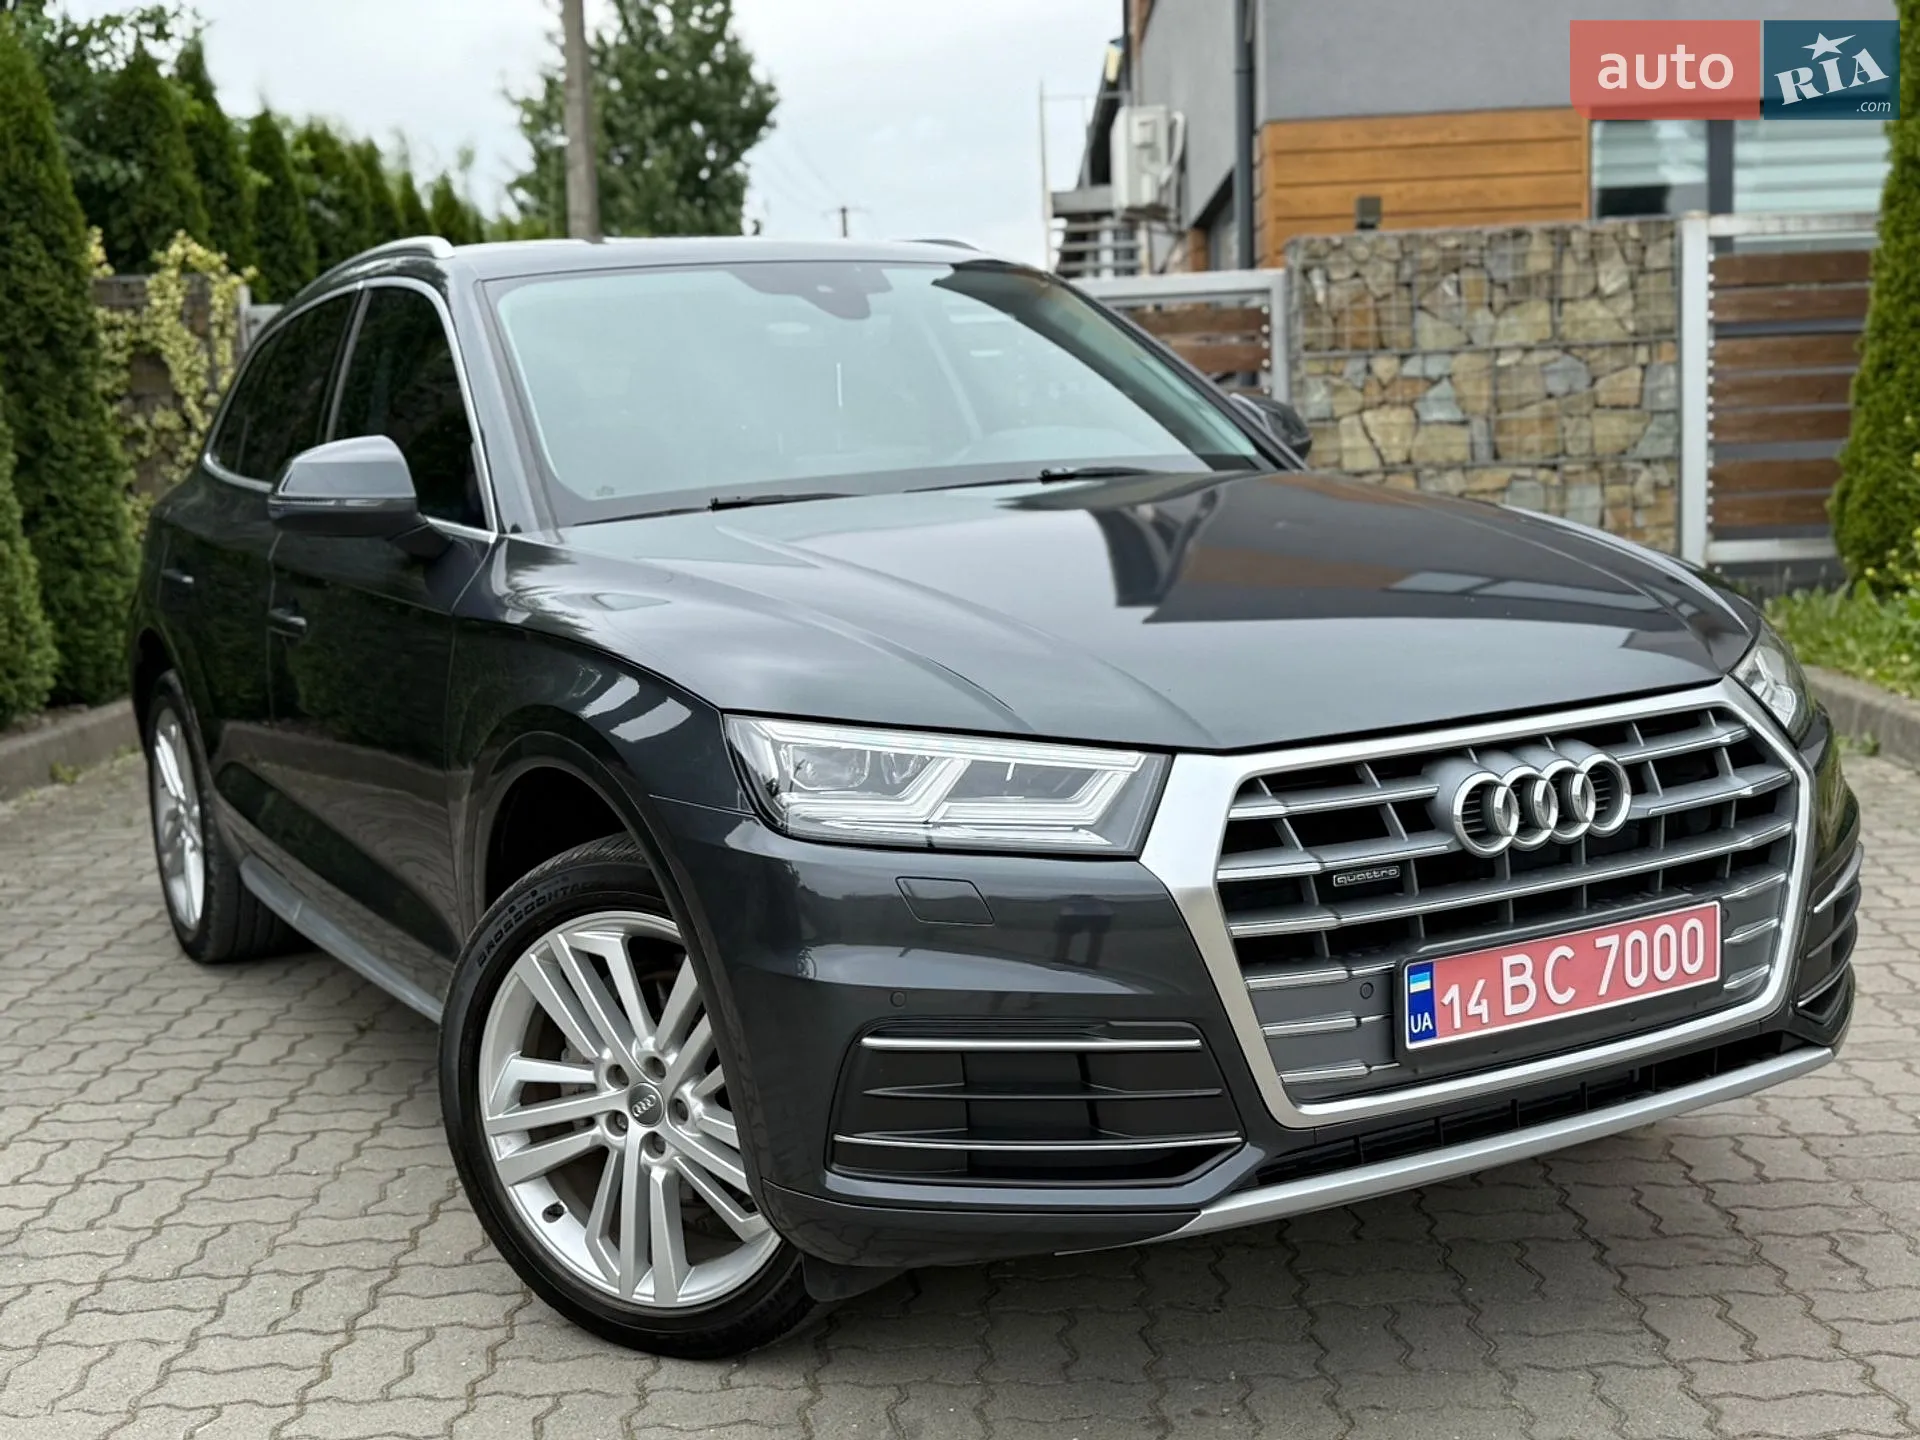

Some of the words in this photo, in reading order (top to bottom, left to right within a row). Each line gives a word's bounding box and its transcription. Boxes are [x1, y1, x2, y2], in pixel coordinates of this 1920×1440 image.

[1336, 868, 1398, 885] quattro
[1440, 978, 1489, 1029] 14
[1503, 945, 1576, 1016] BC
[1595, 917, 1705, 996] 7000
[1410, 1012, 1434, 1034] UA
